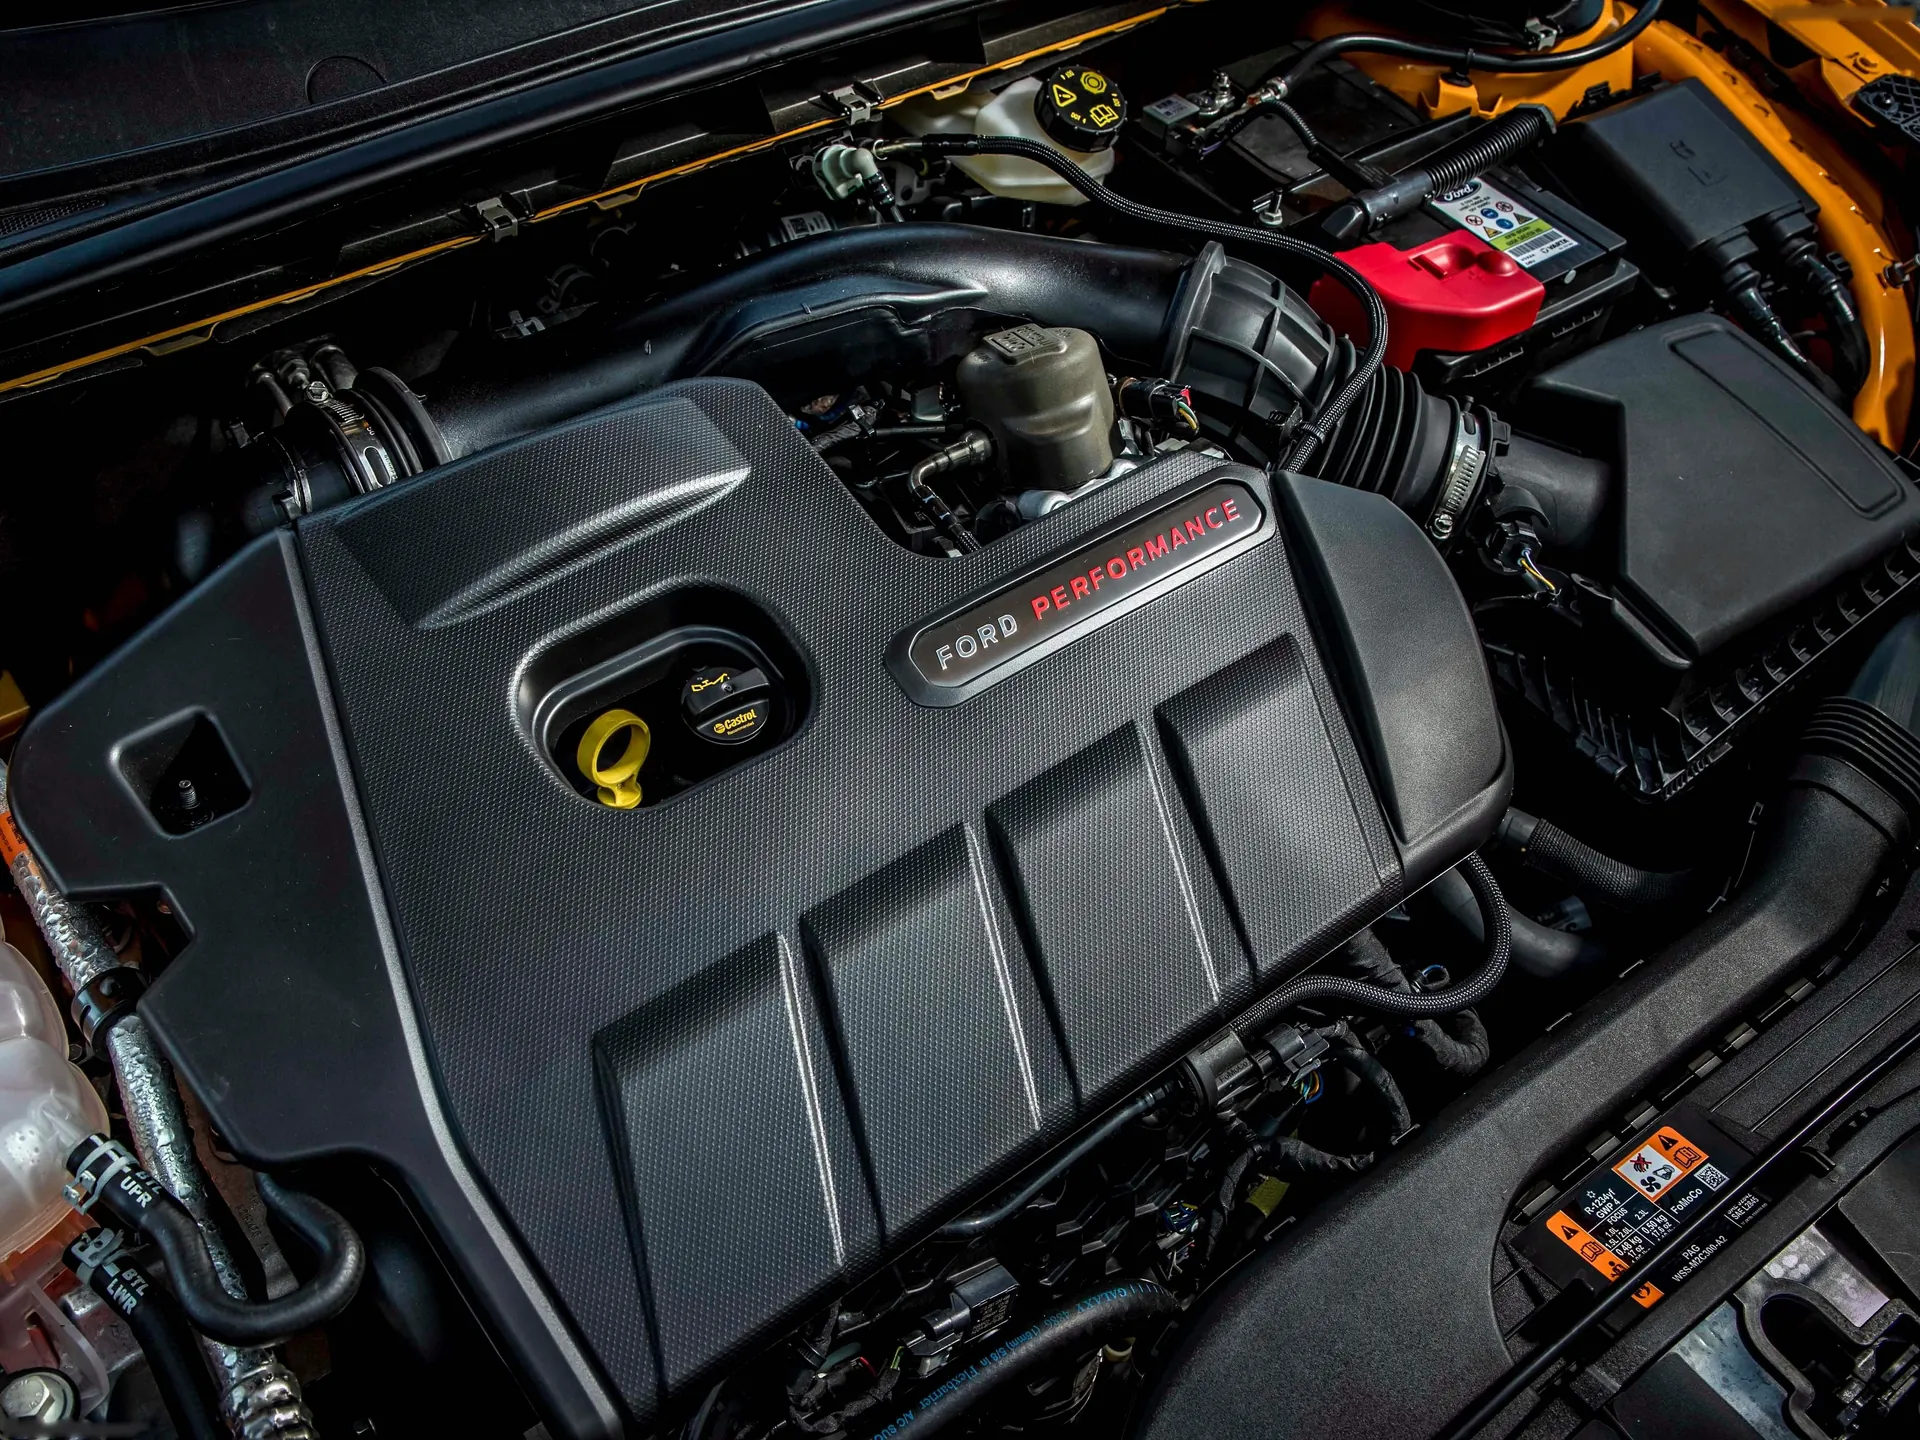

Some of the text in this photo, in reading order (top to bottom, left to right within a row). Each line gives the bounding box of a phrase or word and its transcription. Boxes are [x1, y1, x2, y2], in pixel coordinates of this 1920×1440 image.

[935, 498, 1241, 671] FORD PERFORMANCE
[724, 708, 757, 730] Castrol
[120, 1176, 152, 1208] UPR
[1584, 1188, 1616, 1215] R-1234yf
[1670, 1188, 1703, 1214] FoMoCo
[1596, 1202, 1613, 1218] GWP
[1607, 1208, 1628, 1225] FOCUS
[1634, 1209, 1649, 1220] 2.3L
[1731, 1209, 1746, 1220] SAE
[1605, 1227, 1619, 1238] 1.0L
[1641, 1220, 1658, 1234] 0.50
[1653, 1214, 1668, 1223] kg
[1651, 1226, 1665, 1238] 17.6
[1663, 1221, 1673, 1229] oz
[1615, 1241, 1633, 1256] 0.48
[1628, 1235, 1643, 1245] kg
[1627, 1249, 1637, 1258] 17
[1635, 1244, 1645, 1253] oz
[1682, 1244, 1701, 1260] PAG
[1671, 1235, 1728, 1282] WSS-M2C300-A2
[121, 1268, 149, 1296] BTL
[106, 1278, 138, 1315] LWR
[1075, 1287, 1127, 1314] GALAXY
[1044, 1310, 1070, 1327] 4886
[1004, 1325, 1041, 1351] (16mm)
[990, 1347, 1008, 1361] 5/8
[919, 1365, 980, 1410] Flexbarrier
[896, 1409, 915, 1427] A/C
